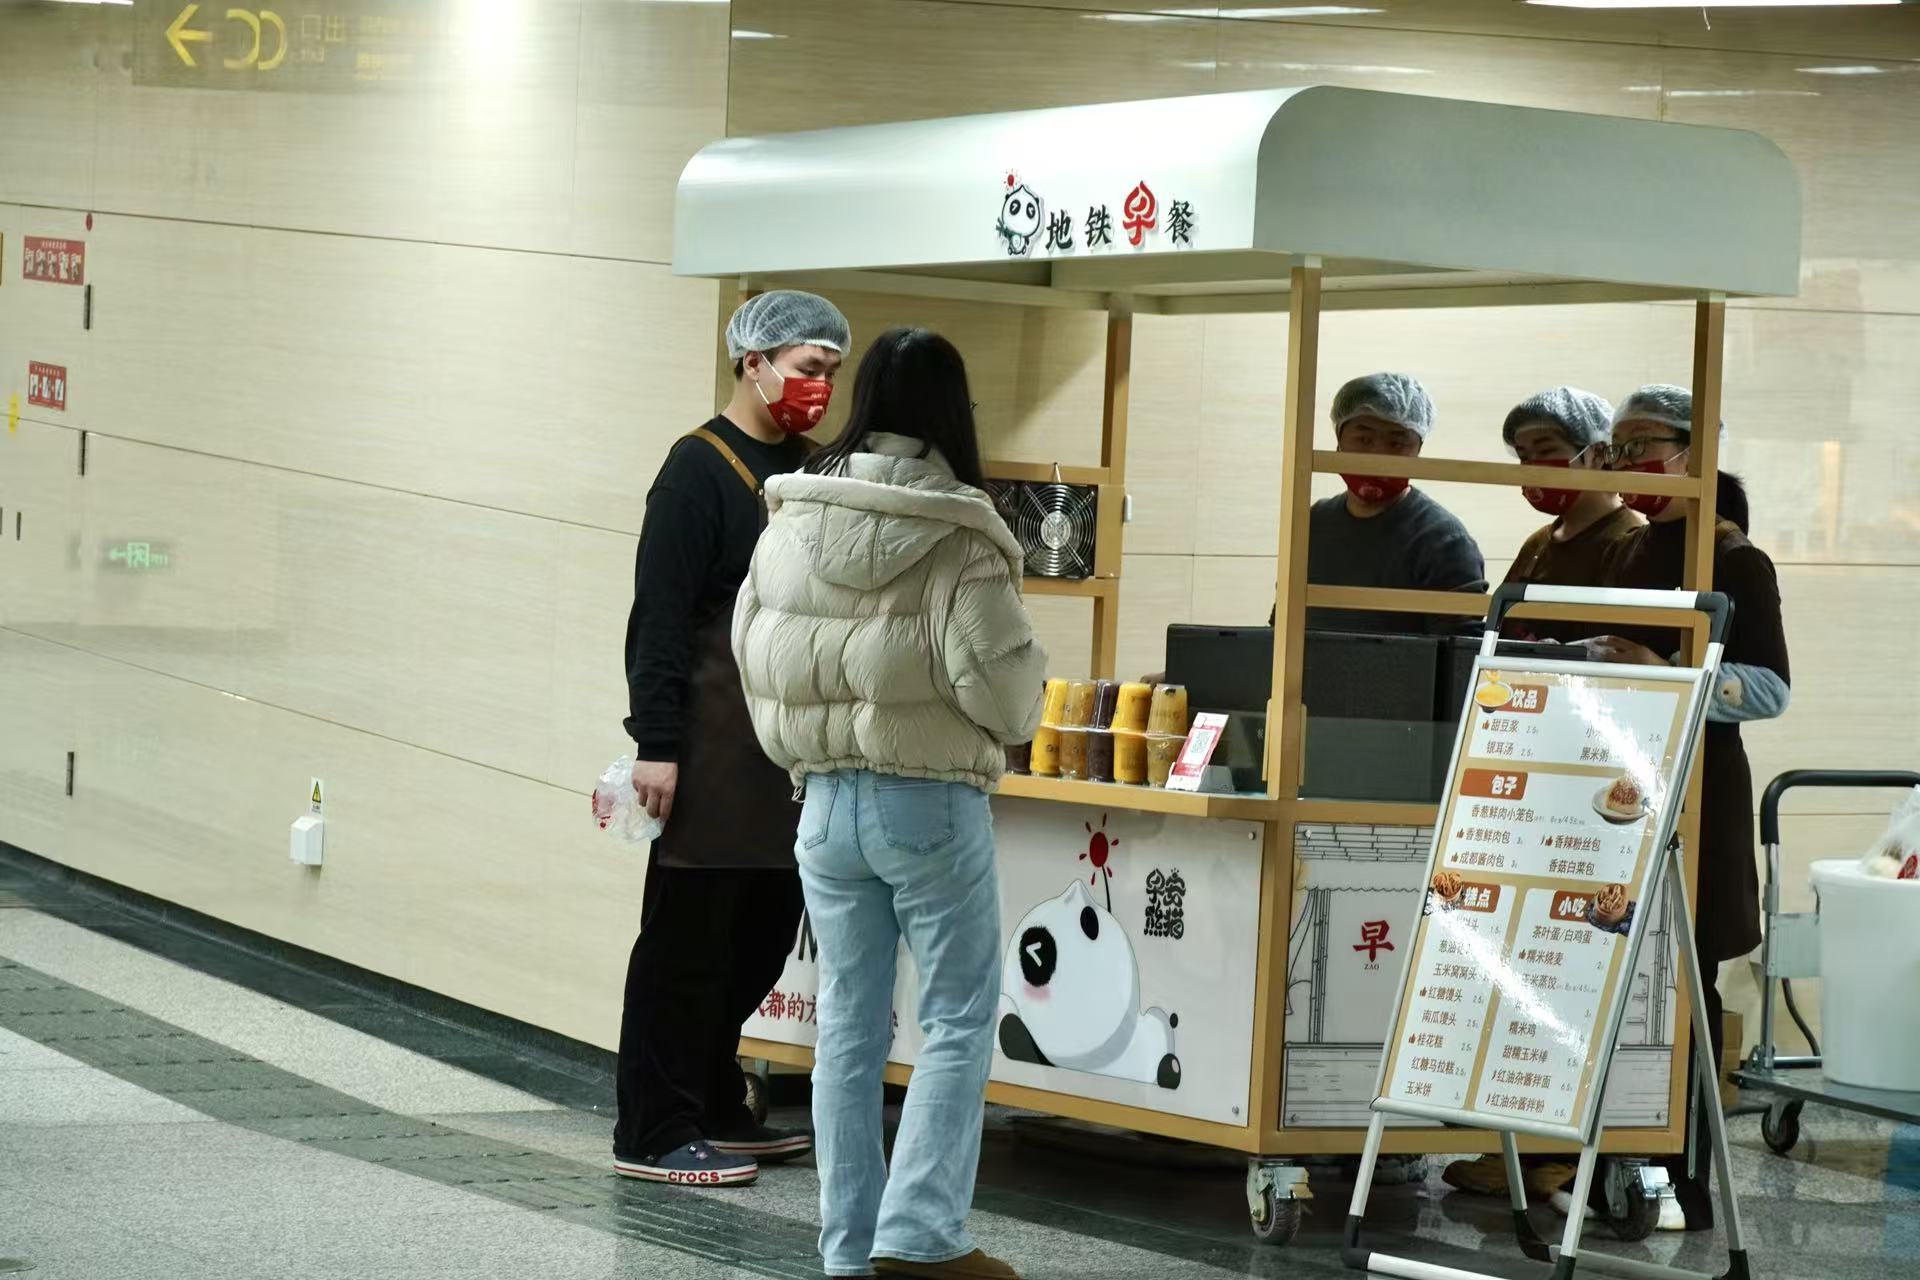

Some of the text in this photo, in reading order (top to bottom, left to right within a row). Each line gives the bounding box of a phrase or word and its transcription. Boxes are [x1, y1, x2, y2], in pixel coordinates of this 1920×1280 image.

[1045, 180, 1194, 250] 地铁早餐
[1512, 688, 1538, 709] 饮品
[1490, 718, 1520, 733] 甜豆浆
[1486, 740, 1514, 756] 银耳汤
[1580, 746, 1610, 762] 黑米粥
[1491, 775, 1518, 796] 包子
[1471, 804, 1534, 823] 香葱鲜肉小笼包
[1466, 828, 1511, 845] 香葱鲜肉包
[1554, 835, 1601, 852] 香辣粉丝包
[1459, 852, 1504, 868] 成都酱肉包
[1548, 859, 1595, 877] 香菇白菜包
[1557, 896, 1587, 917] 小吃
[1352, 920, 1395, 963] 早
[1532, 926, 1592, 944] 茶叶蛋/白鸡蛋
[1527, 948, 1564, 966] 糯米烧麦
[1433, 963, 1478, 980] 玉米窝窝头
[1427, 986, 1463, 1003] 红糖馒头
[1421, 1009, 1457, 1027] 南瓜馒头
[1508, 1020, 1537, 1038] 糯米鸡
[1417, 1033, 1443, 1049] 桂花糕
[1411, 1056, 1455, 1075] 红糖马拉糕
[1496, 1068, 1552, 1089] 红油杂酱拌面
[1405, 1080, 1433, 1098] 玉米饼
[1491, 1092, 1545, 1113] 红油杂酱拌粉
[668, 1171, 720, 1183] crocs
